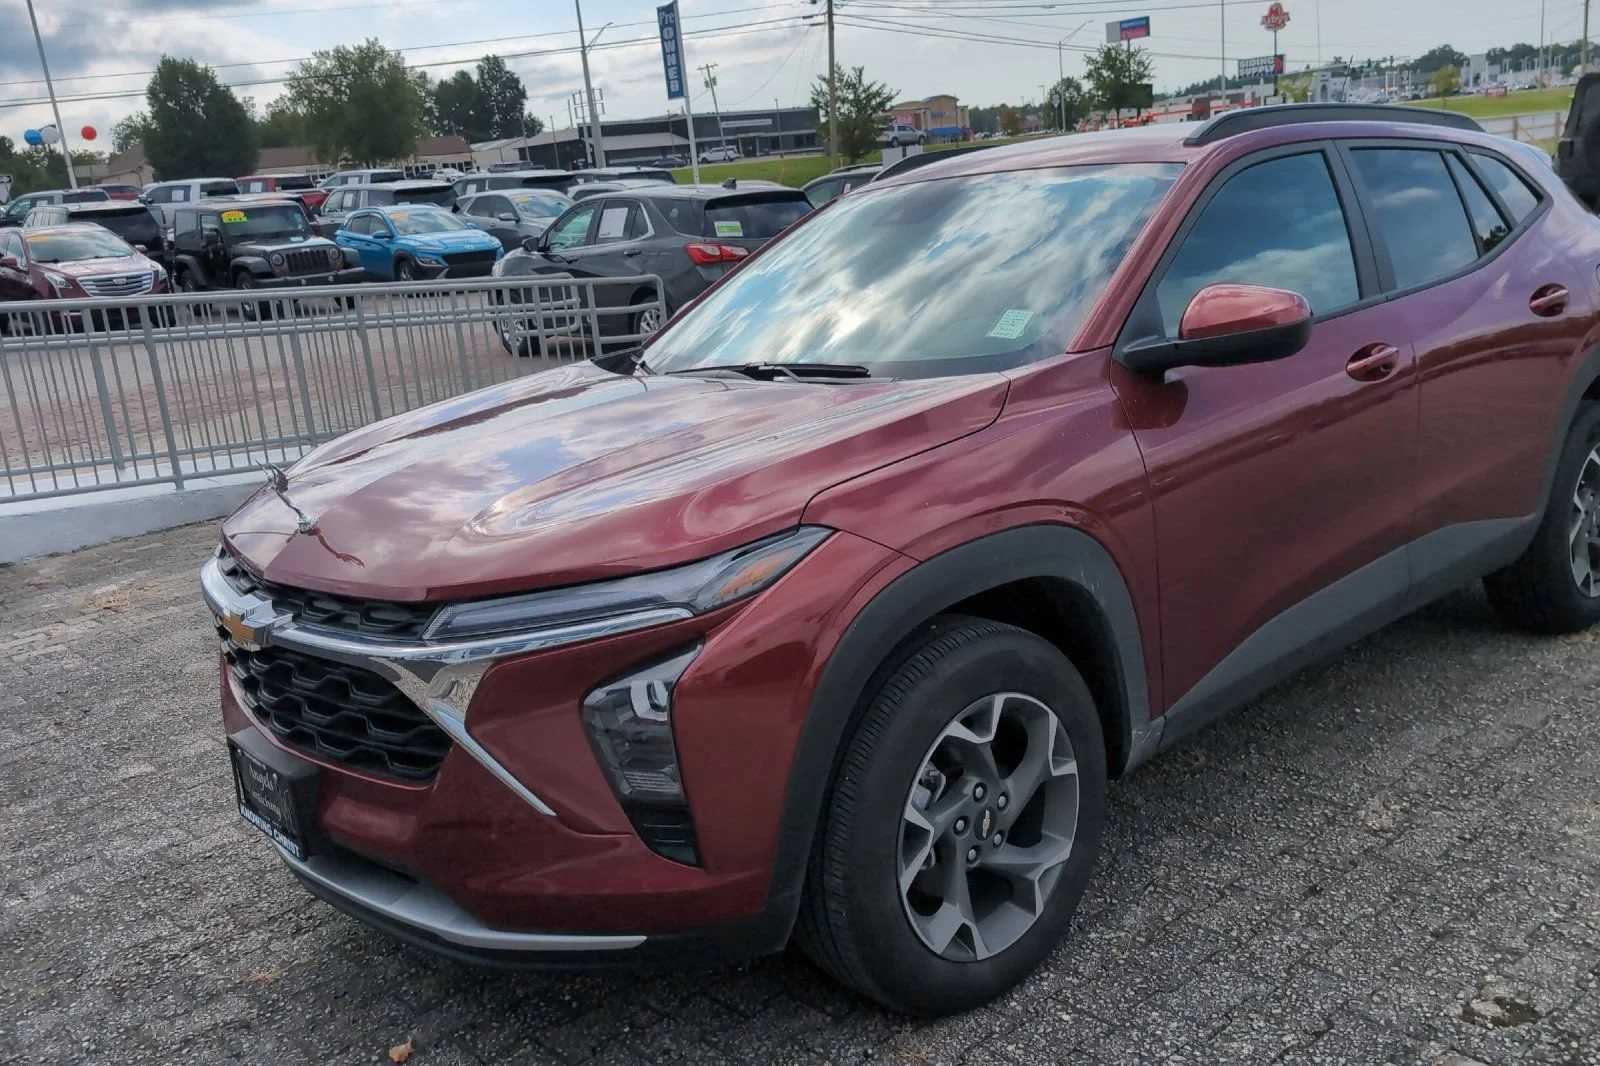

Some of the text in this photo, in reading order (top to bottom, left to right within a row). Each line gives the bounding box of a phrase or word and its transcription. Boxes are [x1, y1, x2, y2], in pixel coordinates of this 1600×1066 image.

[658, 11, 675, 26] Pre
[662, 26, 680, 92] OWNED
[1239, 64, 1276, 77] SUPPLY
[240, 803, 273, 837] KNOWING
[273, 828, 301, 857] CHRIST
